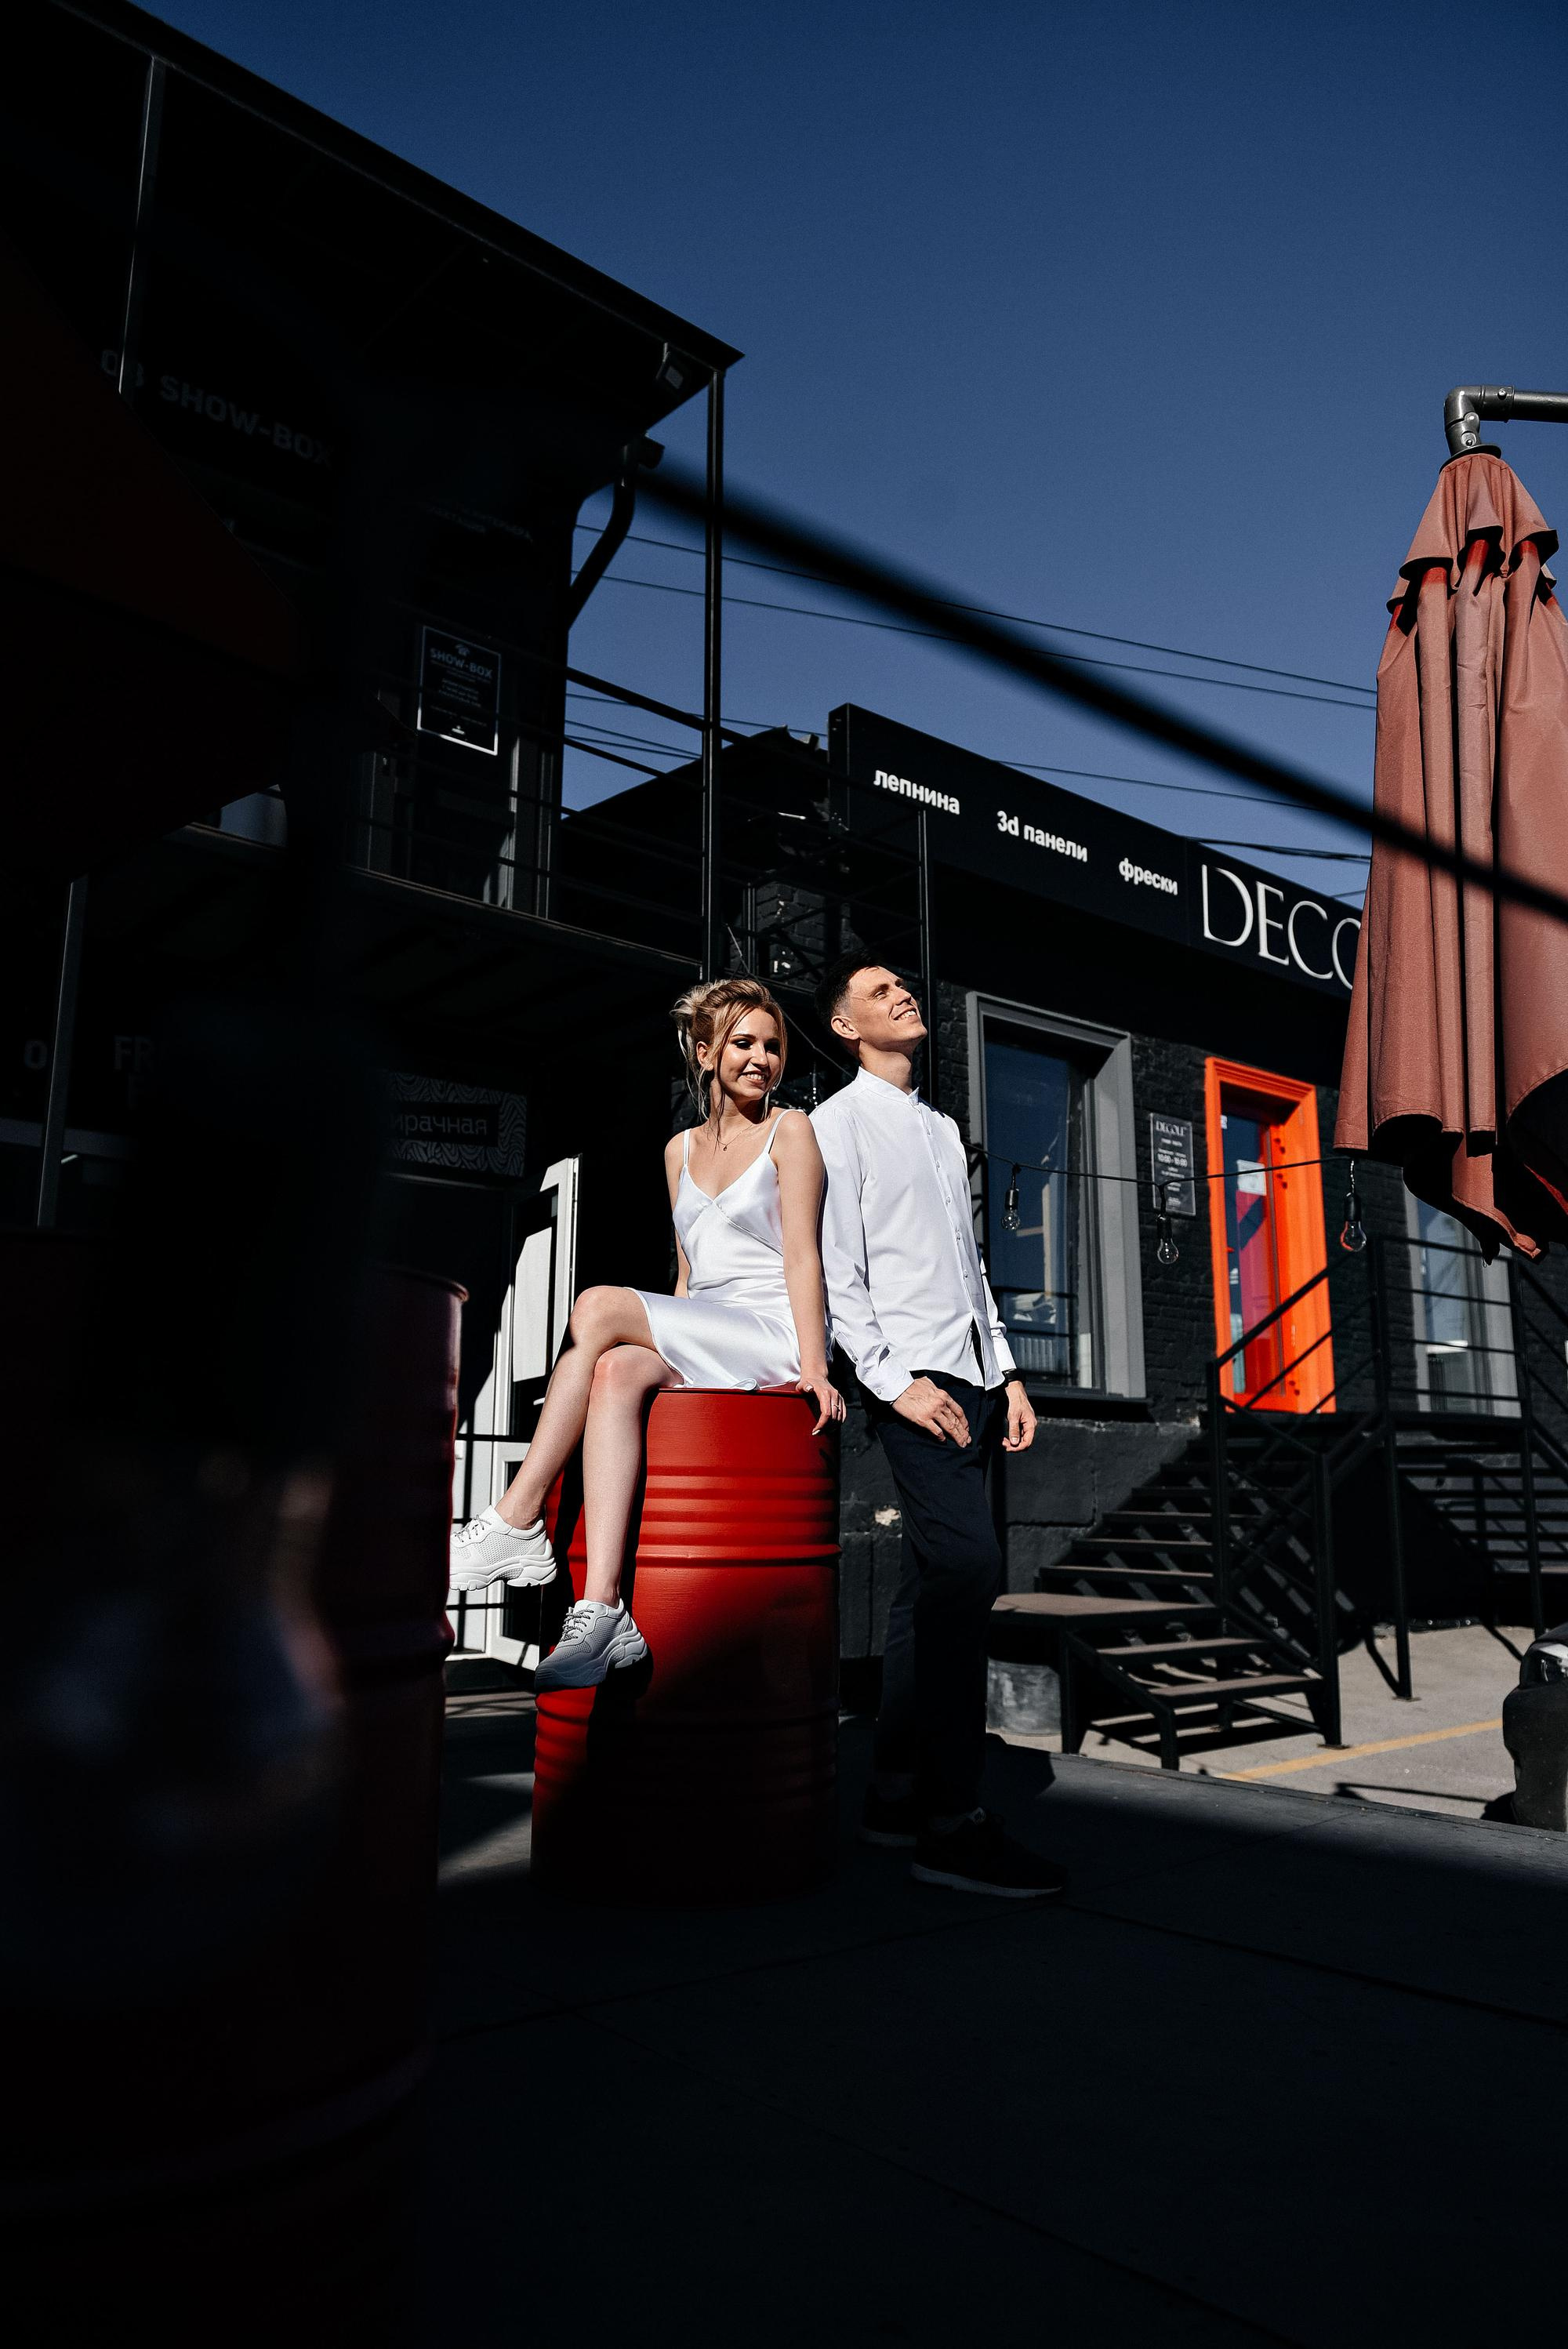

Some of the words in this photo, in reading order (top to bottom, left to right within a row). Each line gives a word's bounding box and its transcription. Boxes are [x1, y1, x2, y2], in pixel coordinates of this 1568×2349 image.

[873, 770, 960, 815] лепнина
[996, 810, 1019, 837] 3d
[1024, 825, 1088, 862] панели
[1119, 858, 1178, 895] фрески
